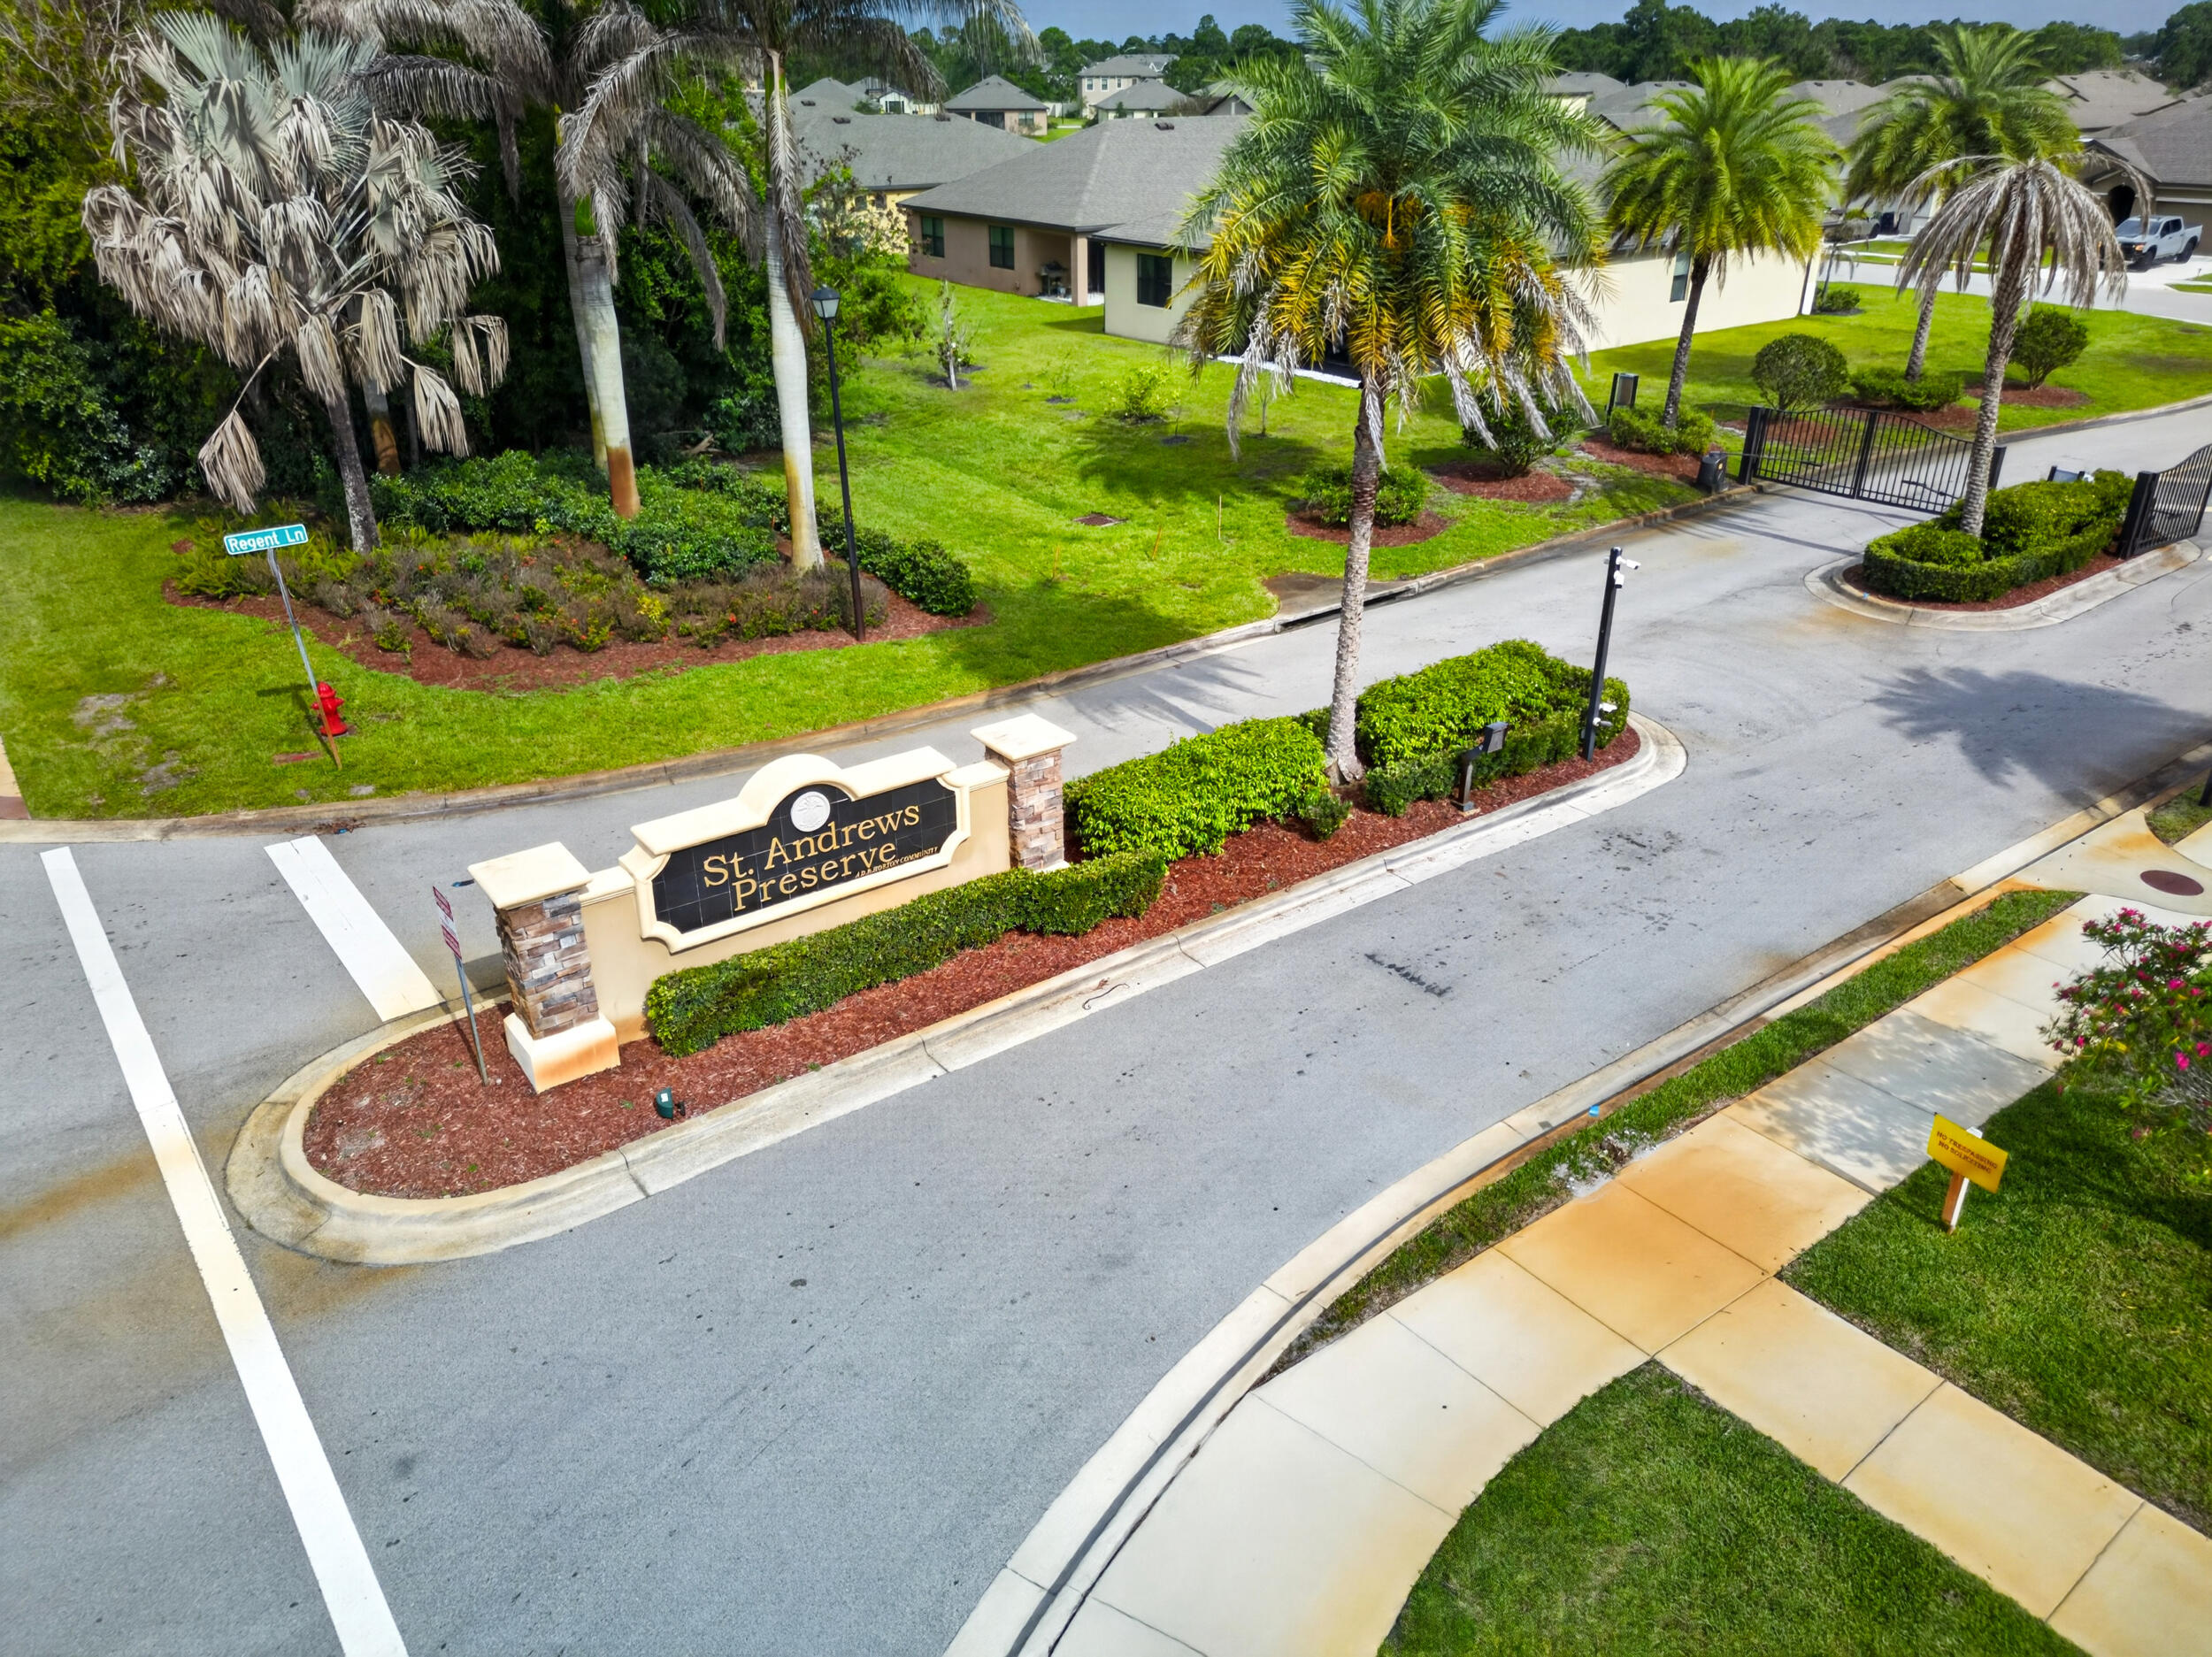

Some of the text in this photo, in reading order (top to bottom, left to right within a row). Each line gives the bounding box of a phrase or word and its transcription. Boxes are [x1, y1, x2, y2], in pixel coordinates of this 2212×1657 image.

[227, 529, 304, 553] Regent Ln
[703, 804, 920, 888] St. Andrews
[732, 842, 896, 912] Preserve
[1937, 1131, 1947, 1140] NO
[1939, 1140, 1949, 1150] NO
